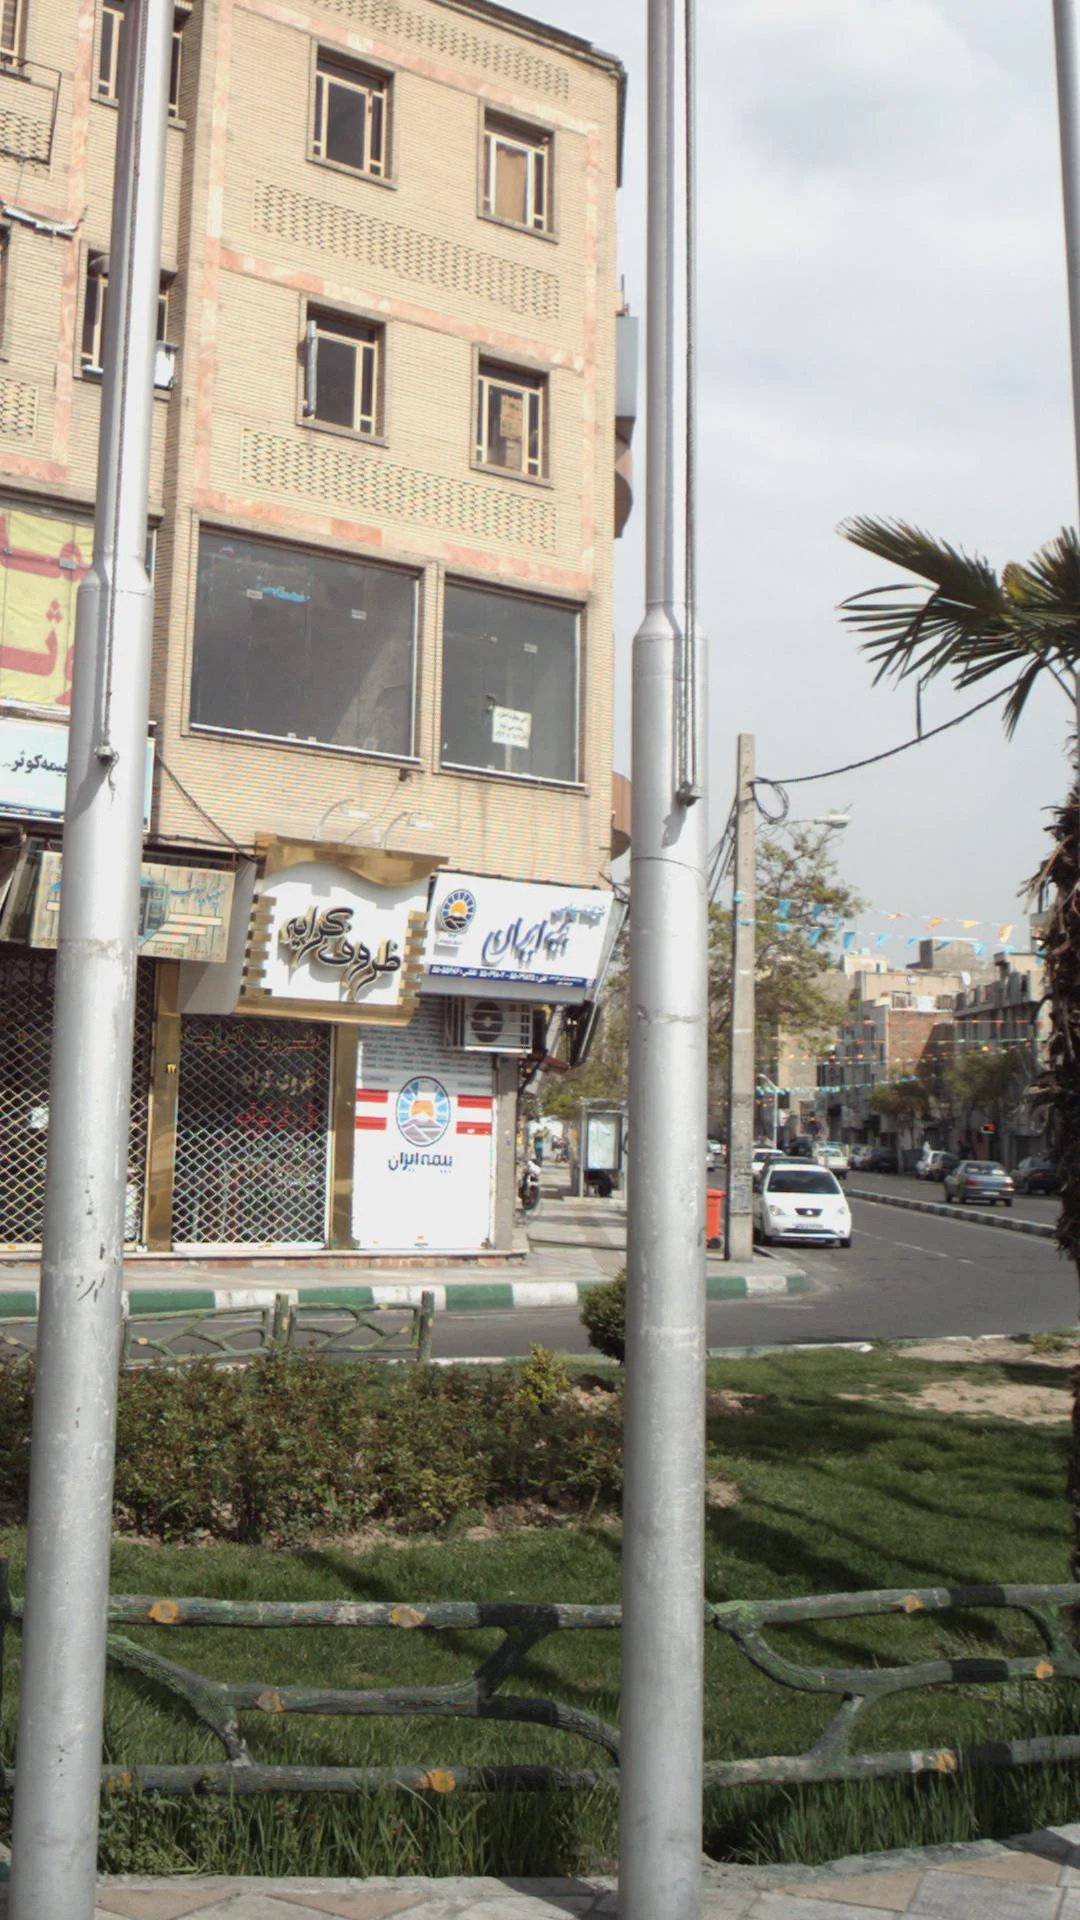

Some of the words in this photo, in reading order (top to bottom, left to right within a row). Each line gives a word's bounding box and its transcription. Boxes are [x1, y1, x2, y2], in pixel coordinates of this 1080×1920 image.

[10, 750, 43, 774] کوثر
[285, 905, 354, 965] کرایه
[317, 939, 402, 998] ظروف
[388, 1151, 419, 1172] ایران
[420, 1153, 453, 1174] بیمه
